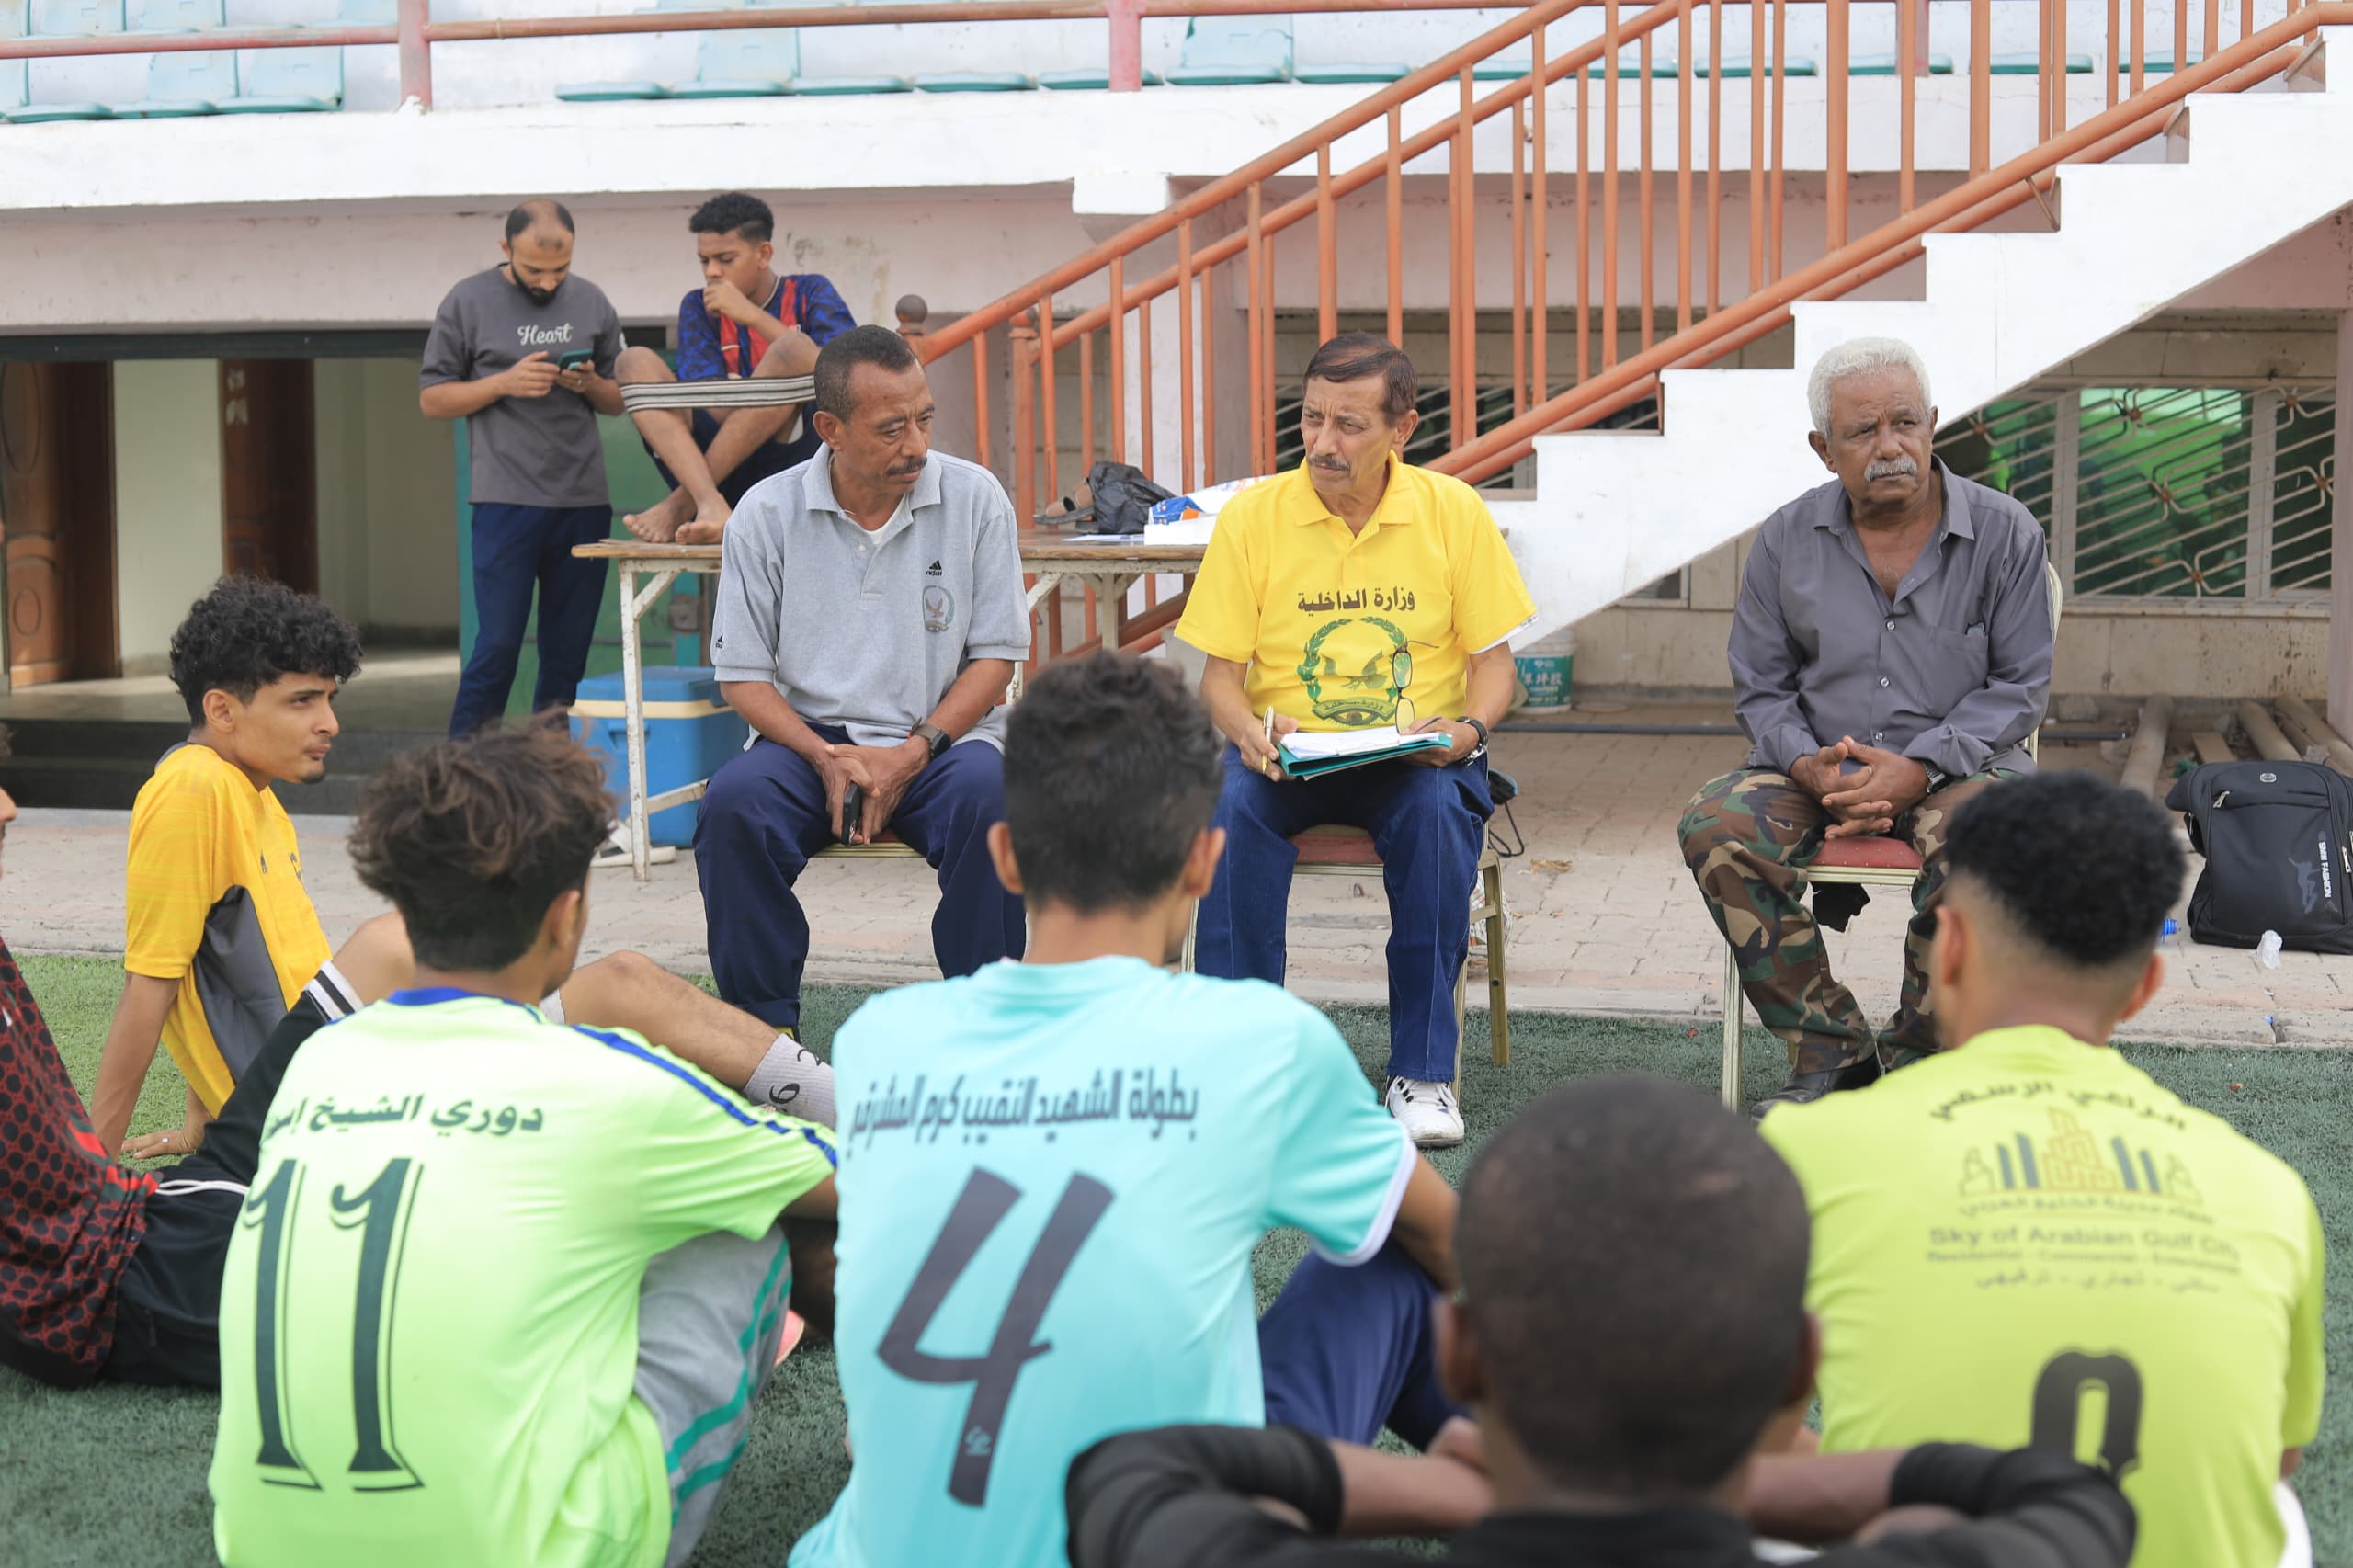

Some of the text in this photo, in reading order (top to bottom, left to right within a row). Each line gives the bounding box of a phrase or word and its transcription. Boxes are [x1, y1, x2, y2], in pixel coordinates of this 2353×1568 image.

[517, 323, 574, 346] Heart
[1298, 585, 1415, 617] وزارة الداخلية
[309, 1094, 425, 1131] الشيخ
[430, 1100, 544, 1137] دوري
[915, 1074, 964, 1144] كرم
[962, 1075, 1037, 1145] النقيب
[1034, 1068, 1123, 1142] الشهيد
[1129, 1066, 1199, 1141] بطولة
[1929, 1225, 2242, 1264] Sky of Arabian Gulf City
[242, 1157, 426, 1494] 11
[876, 1165, 1117, 1508] 4
